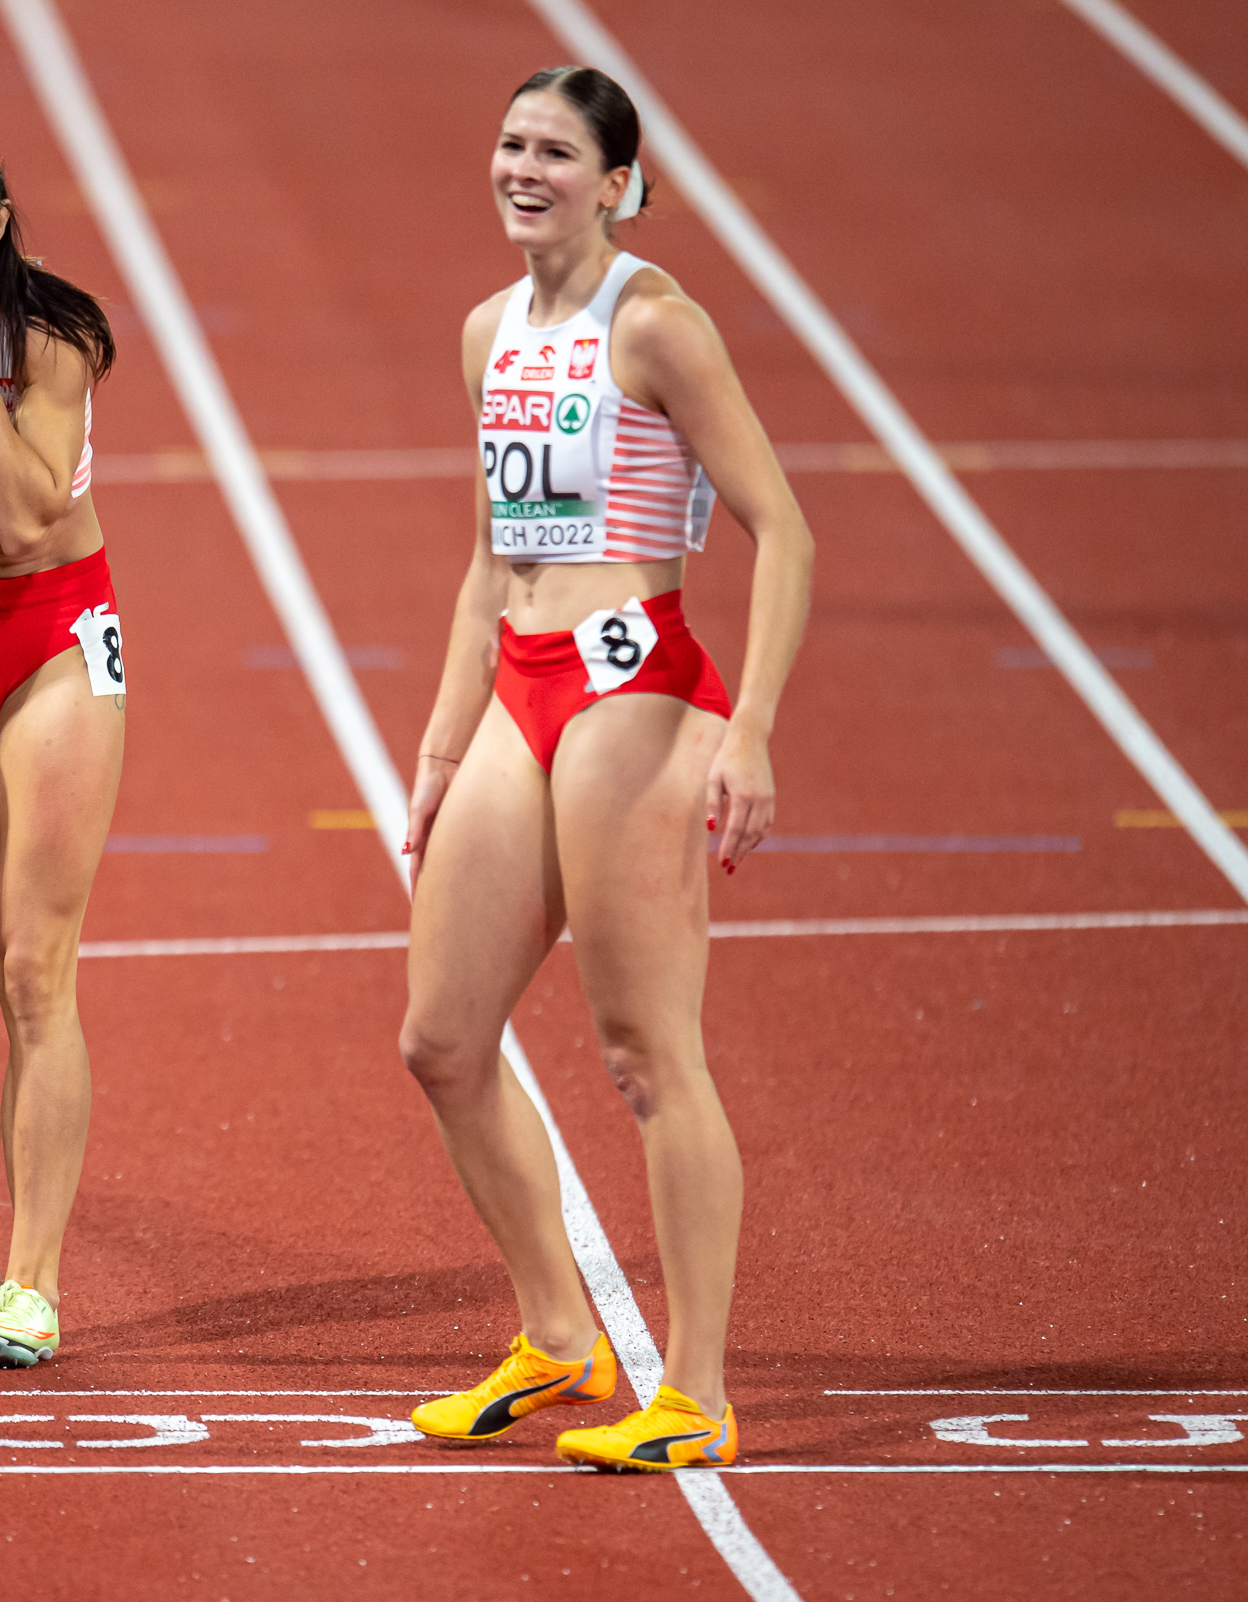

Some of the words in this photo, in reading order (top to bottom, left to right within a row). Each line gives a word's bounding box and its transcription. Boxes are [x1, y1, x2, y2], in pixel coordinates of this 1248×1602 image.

[522, 368, 553, 379] ORLEN
[482, 393, 550, 427] SPAR
[484, 441, 582, 502] POL
[535, 523, 594, 547] 2022
[102, 626, 124, 683] 8
[601, 617, 642, 671] 8
